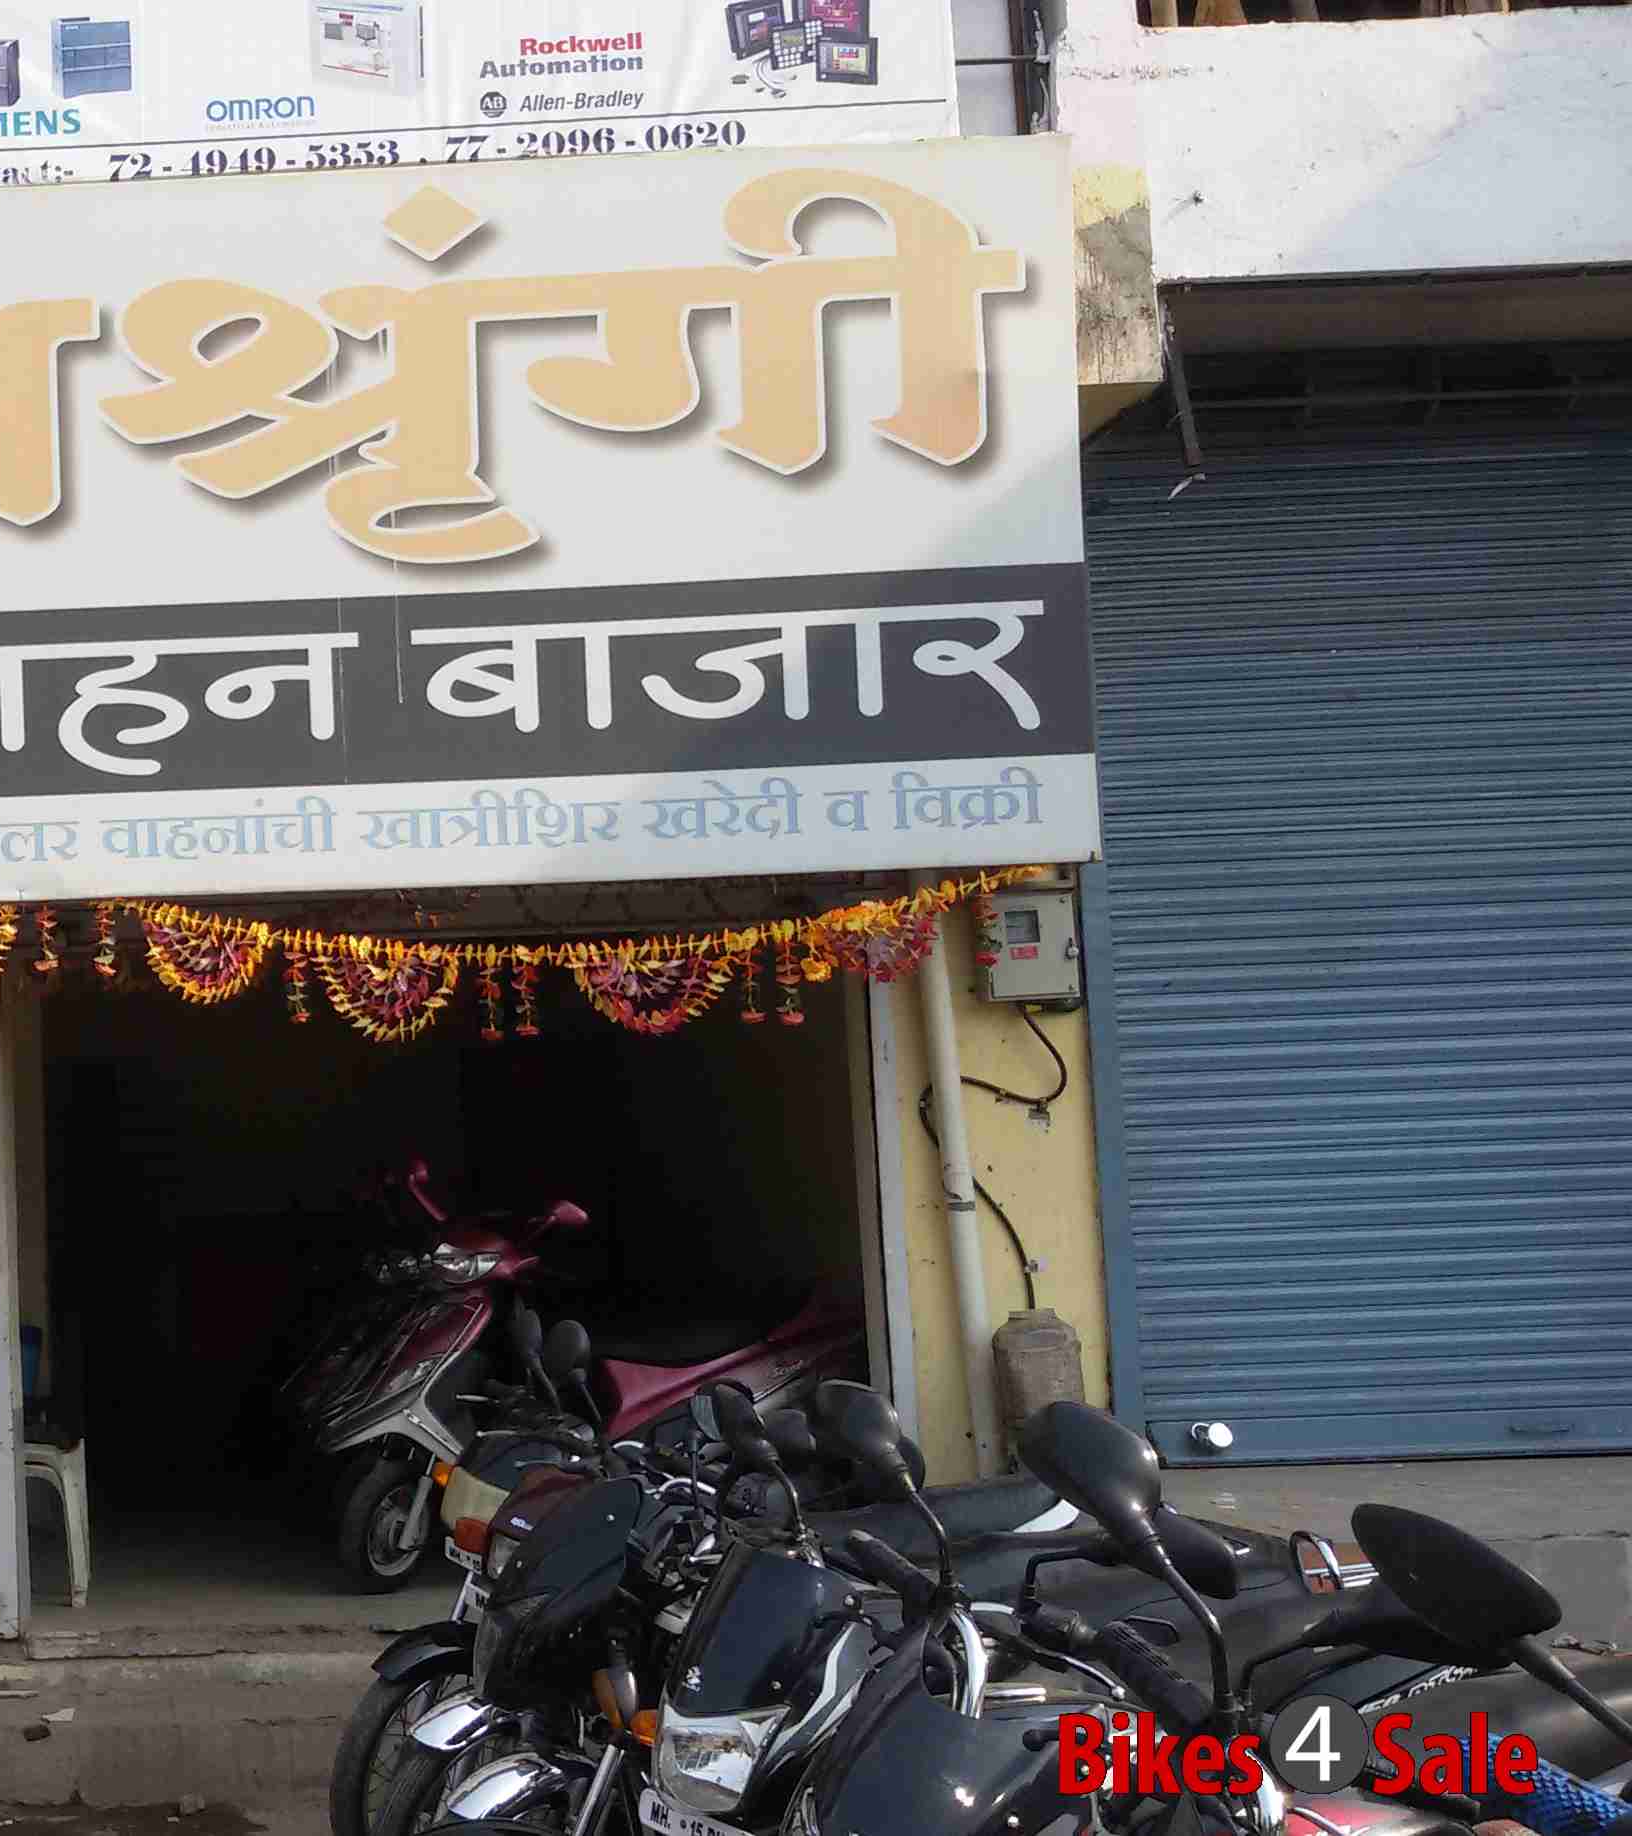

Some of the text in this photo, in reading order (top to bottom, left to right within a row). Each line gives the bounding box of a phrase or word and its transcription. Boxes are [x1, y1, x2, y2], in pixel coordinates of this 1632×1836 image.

[520, 32, 642, 56] Rockwell
[480, 54, 644, 79] Automation
[206, 96, 315, 122] OMRON
[520, 89, 644, 113] Allen-Bradley
[410, 599, 1045, 735] बाजार
[98, 795, 337, 860] वाहनांची
[356, 786, 622, 850] खात्रीशिर
[640, 775, 804, 841] खरेदी
[822, 789, 870, 831] व
[888, 765, 1045, 831] विक्री
